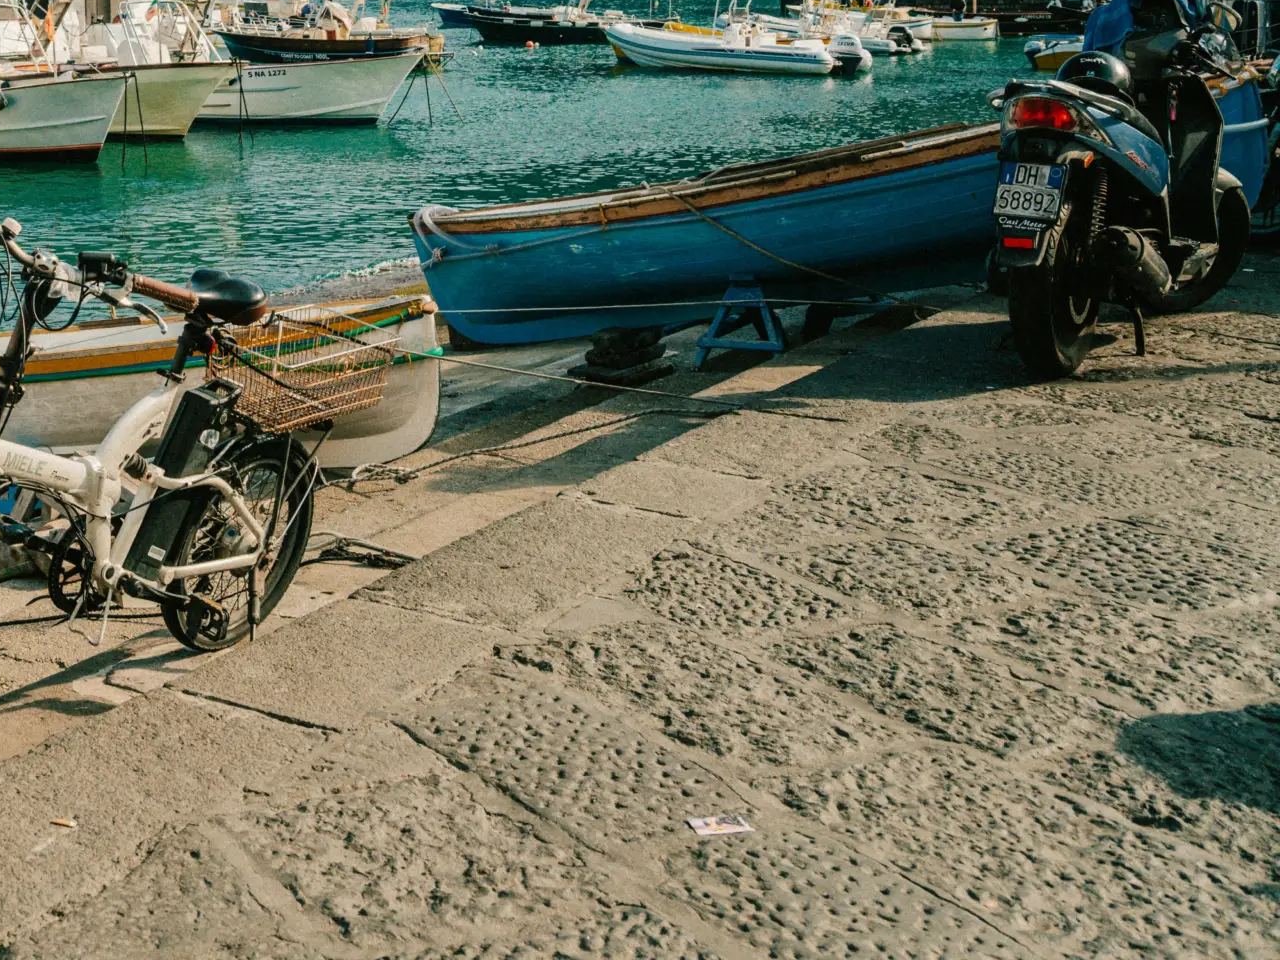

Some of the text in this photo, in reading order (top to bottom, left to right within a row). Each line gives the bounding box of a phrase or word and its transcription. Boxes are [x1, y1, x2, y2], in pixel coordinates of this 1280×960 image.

[267, 69, 287, 77] 1272
[1015, 164, 1040, 185] DH
[998, 189, 1057, 213] 58892
[1019, 220, 1047, 228] Motor
[2, 451, 48, 476] MIELE
